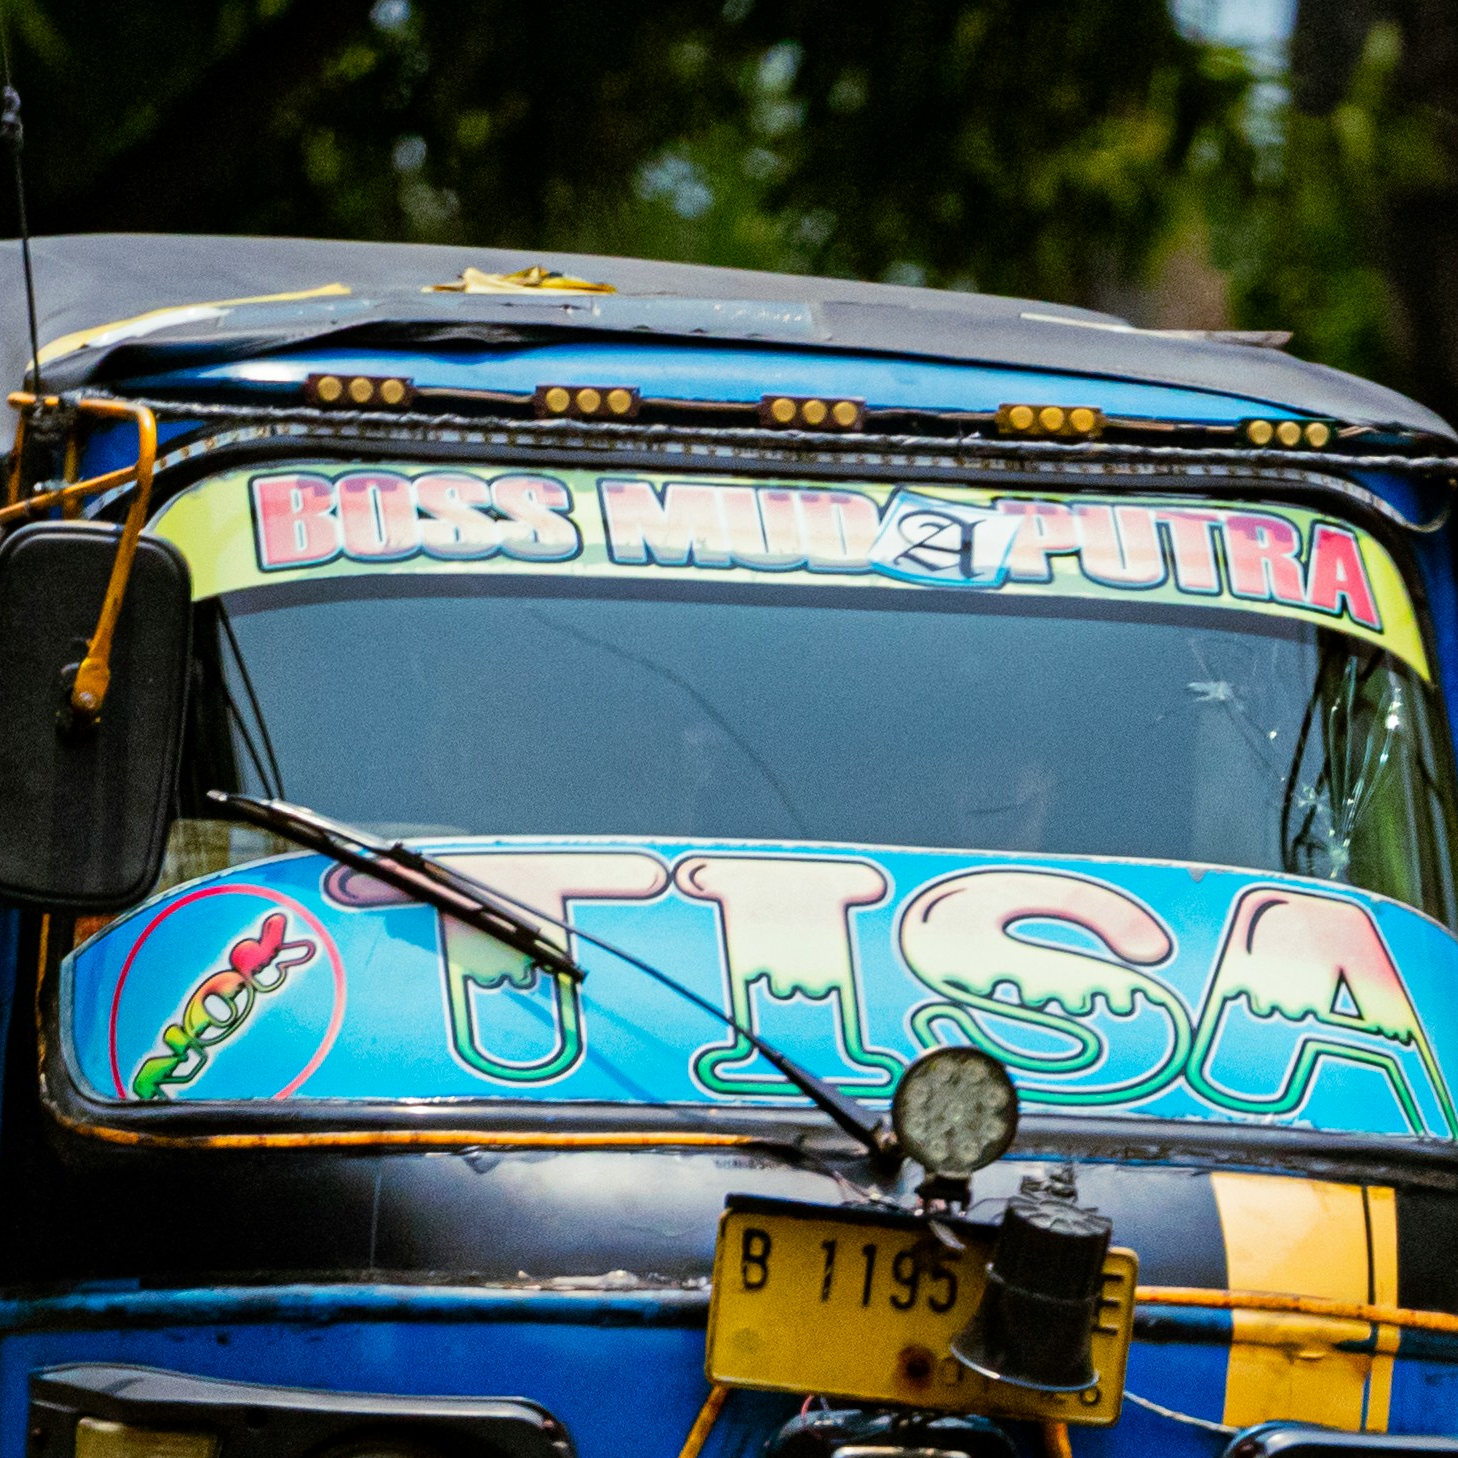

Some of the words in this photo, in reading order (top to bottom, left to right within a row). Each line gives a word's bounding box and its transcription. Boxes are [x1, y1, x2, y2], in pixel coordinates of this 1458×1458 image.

[249, 470, 584, 573] BOSS
[991, 498, 1383, 635] PUTRA
[742, 1227, 771, 1291] B
[821, 1239, 961, 1314] 1195
